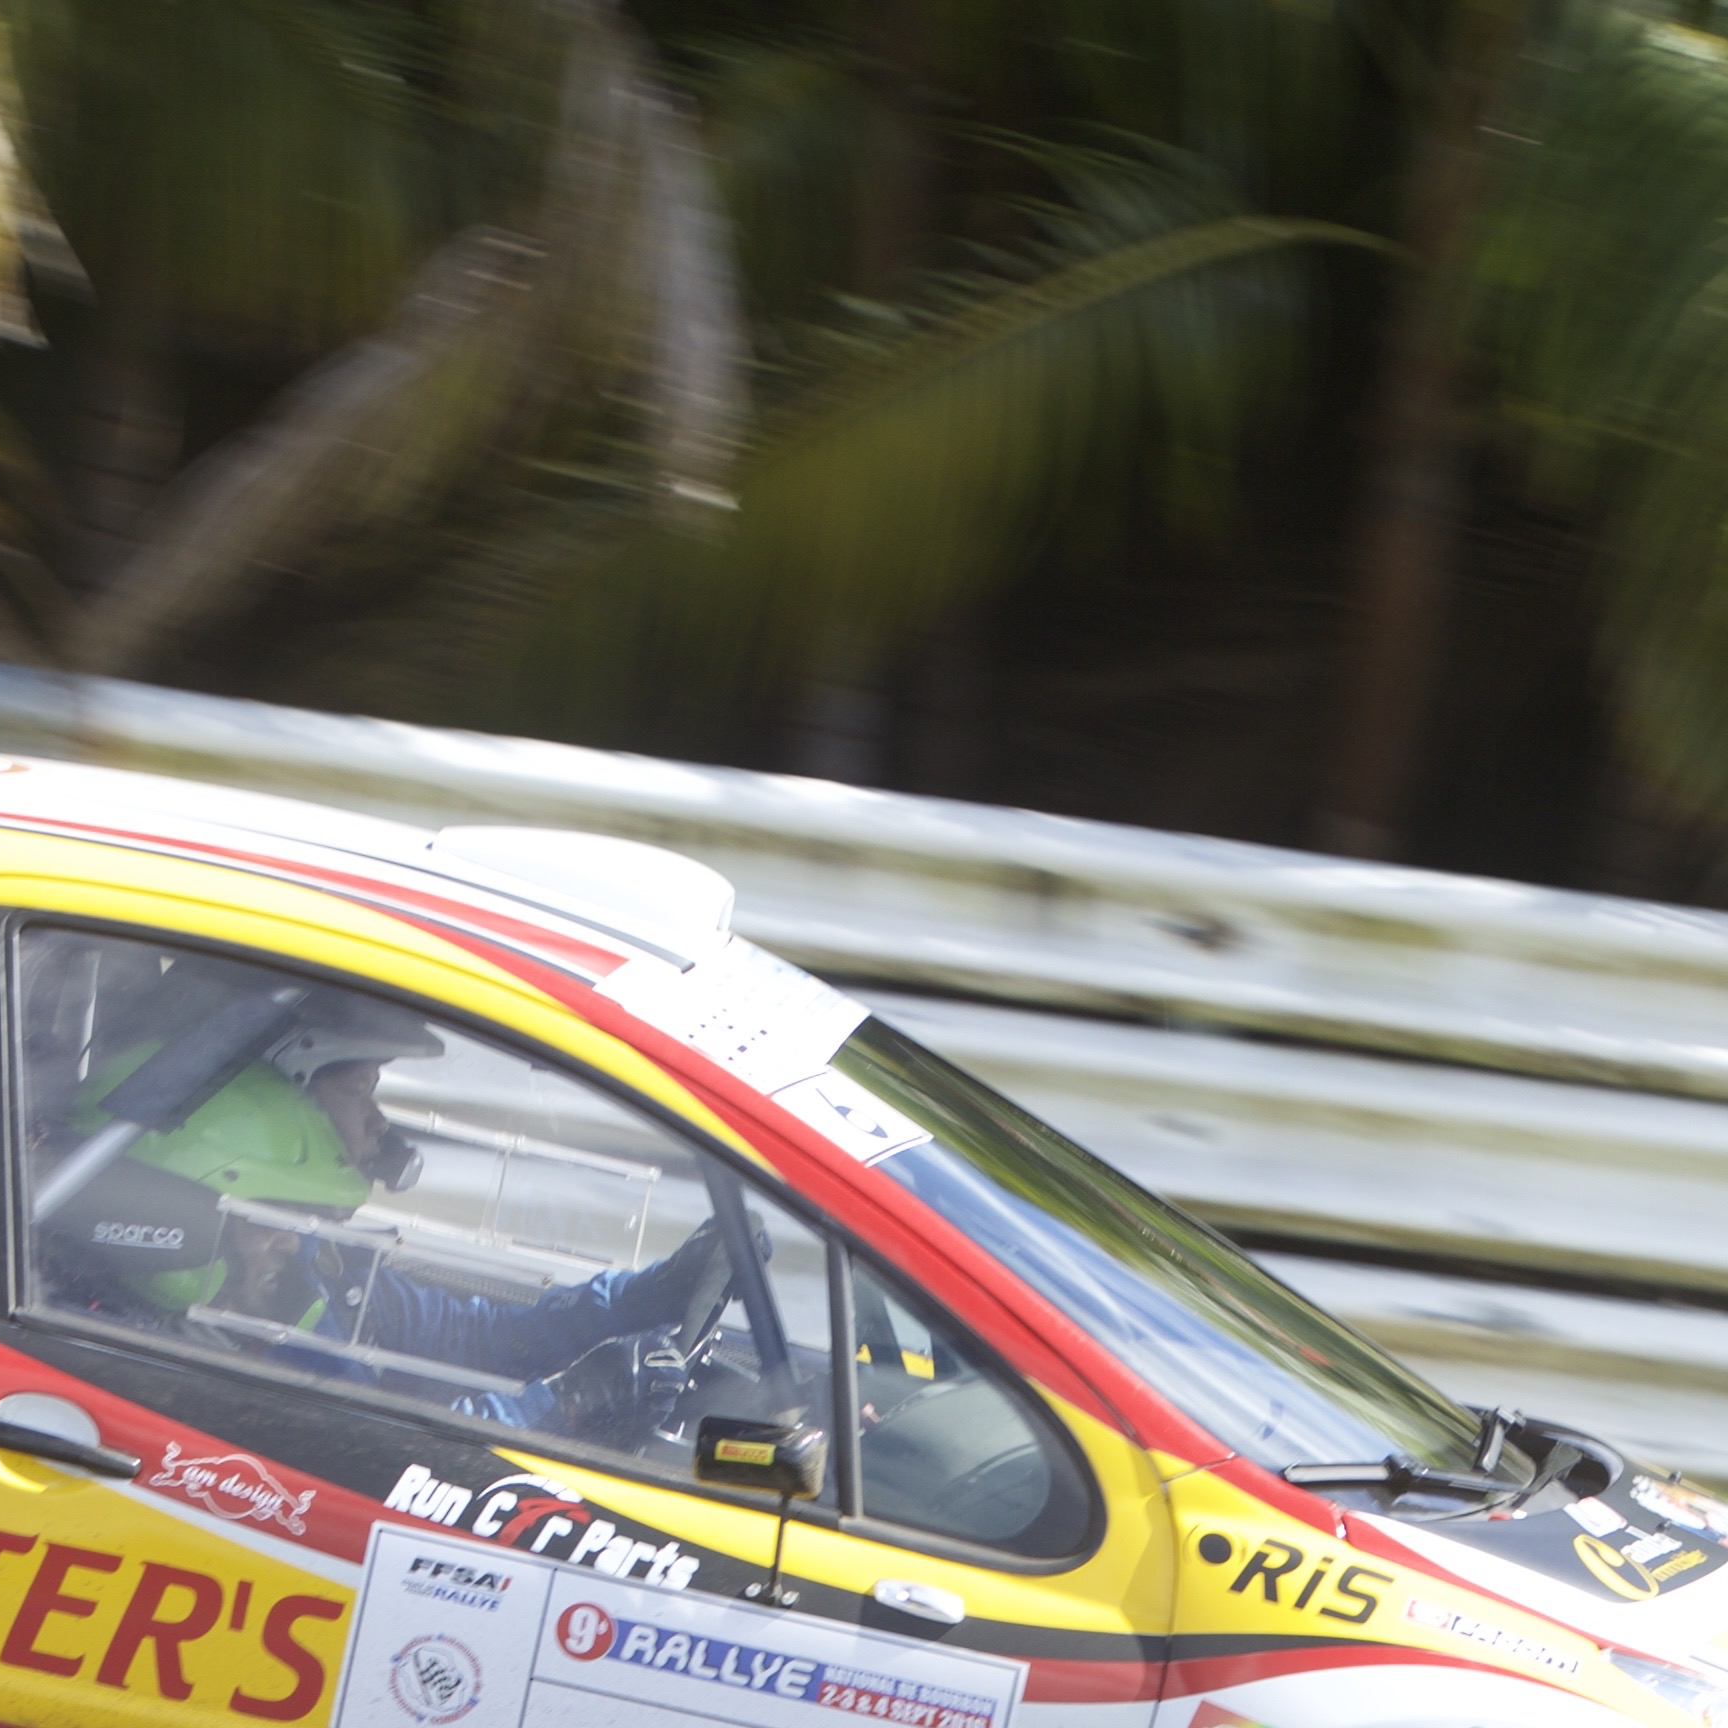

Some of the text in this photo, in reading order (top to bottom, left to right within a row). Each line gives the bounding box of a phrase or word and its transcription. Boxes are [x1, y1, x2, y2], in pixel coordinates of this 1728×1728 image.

[92, 1221, 185, 1248] sparco
[383, 1463, 473, 1527] Run
[567, 1519, 700, 1591] Parts
[619, 1623, 816, 1699] RALLYE
